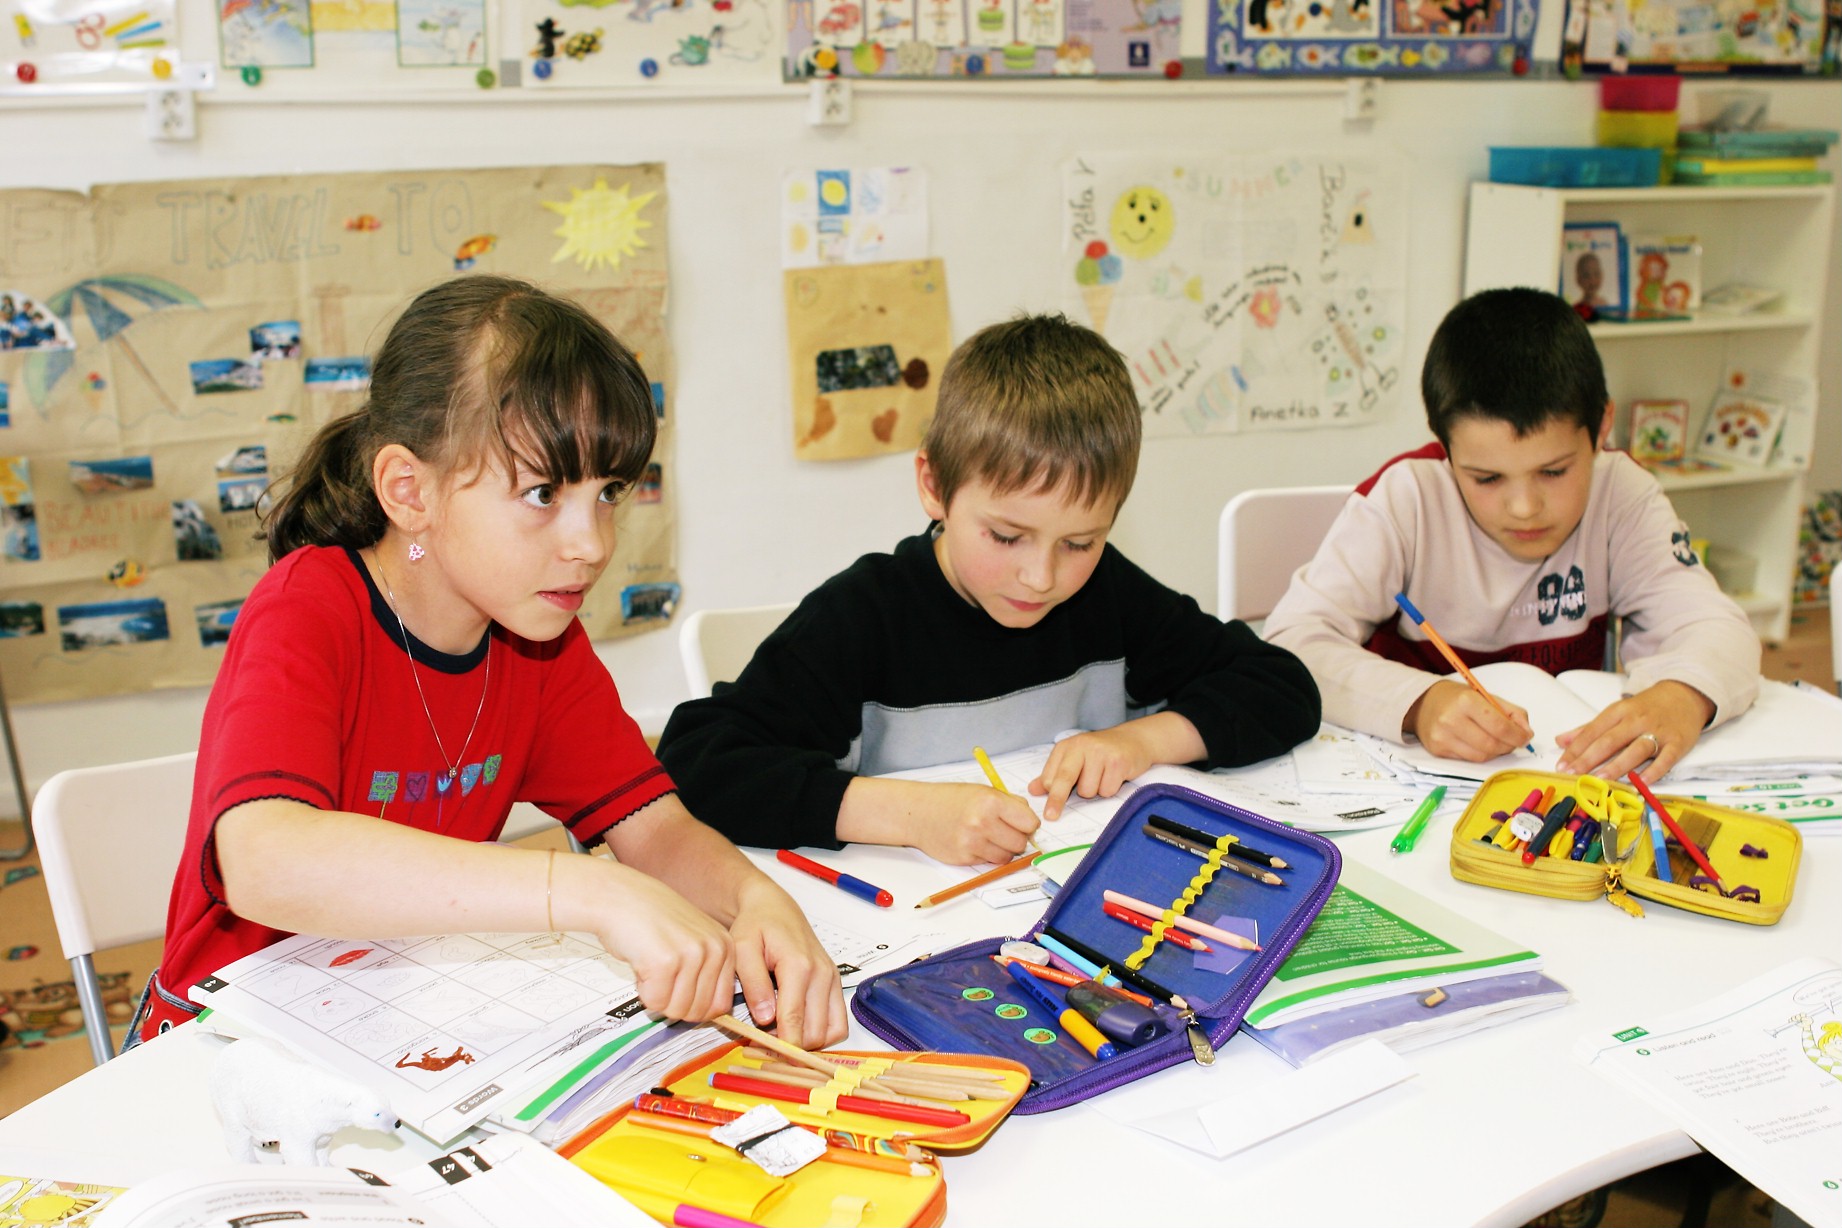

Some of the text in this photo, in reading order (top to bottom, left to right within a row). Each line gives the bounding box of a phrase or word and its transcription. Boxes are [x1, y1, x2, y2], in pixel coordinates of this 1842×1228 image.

[157, 187, 341, 271] TRAVEL
[388, 178, 474, 256] TO
[1617, 1030, 1636, 1039] UNIT
[459, 1086, 498, 1112] Words 3
